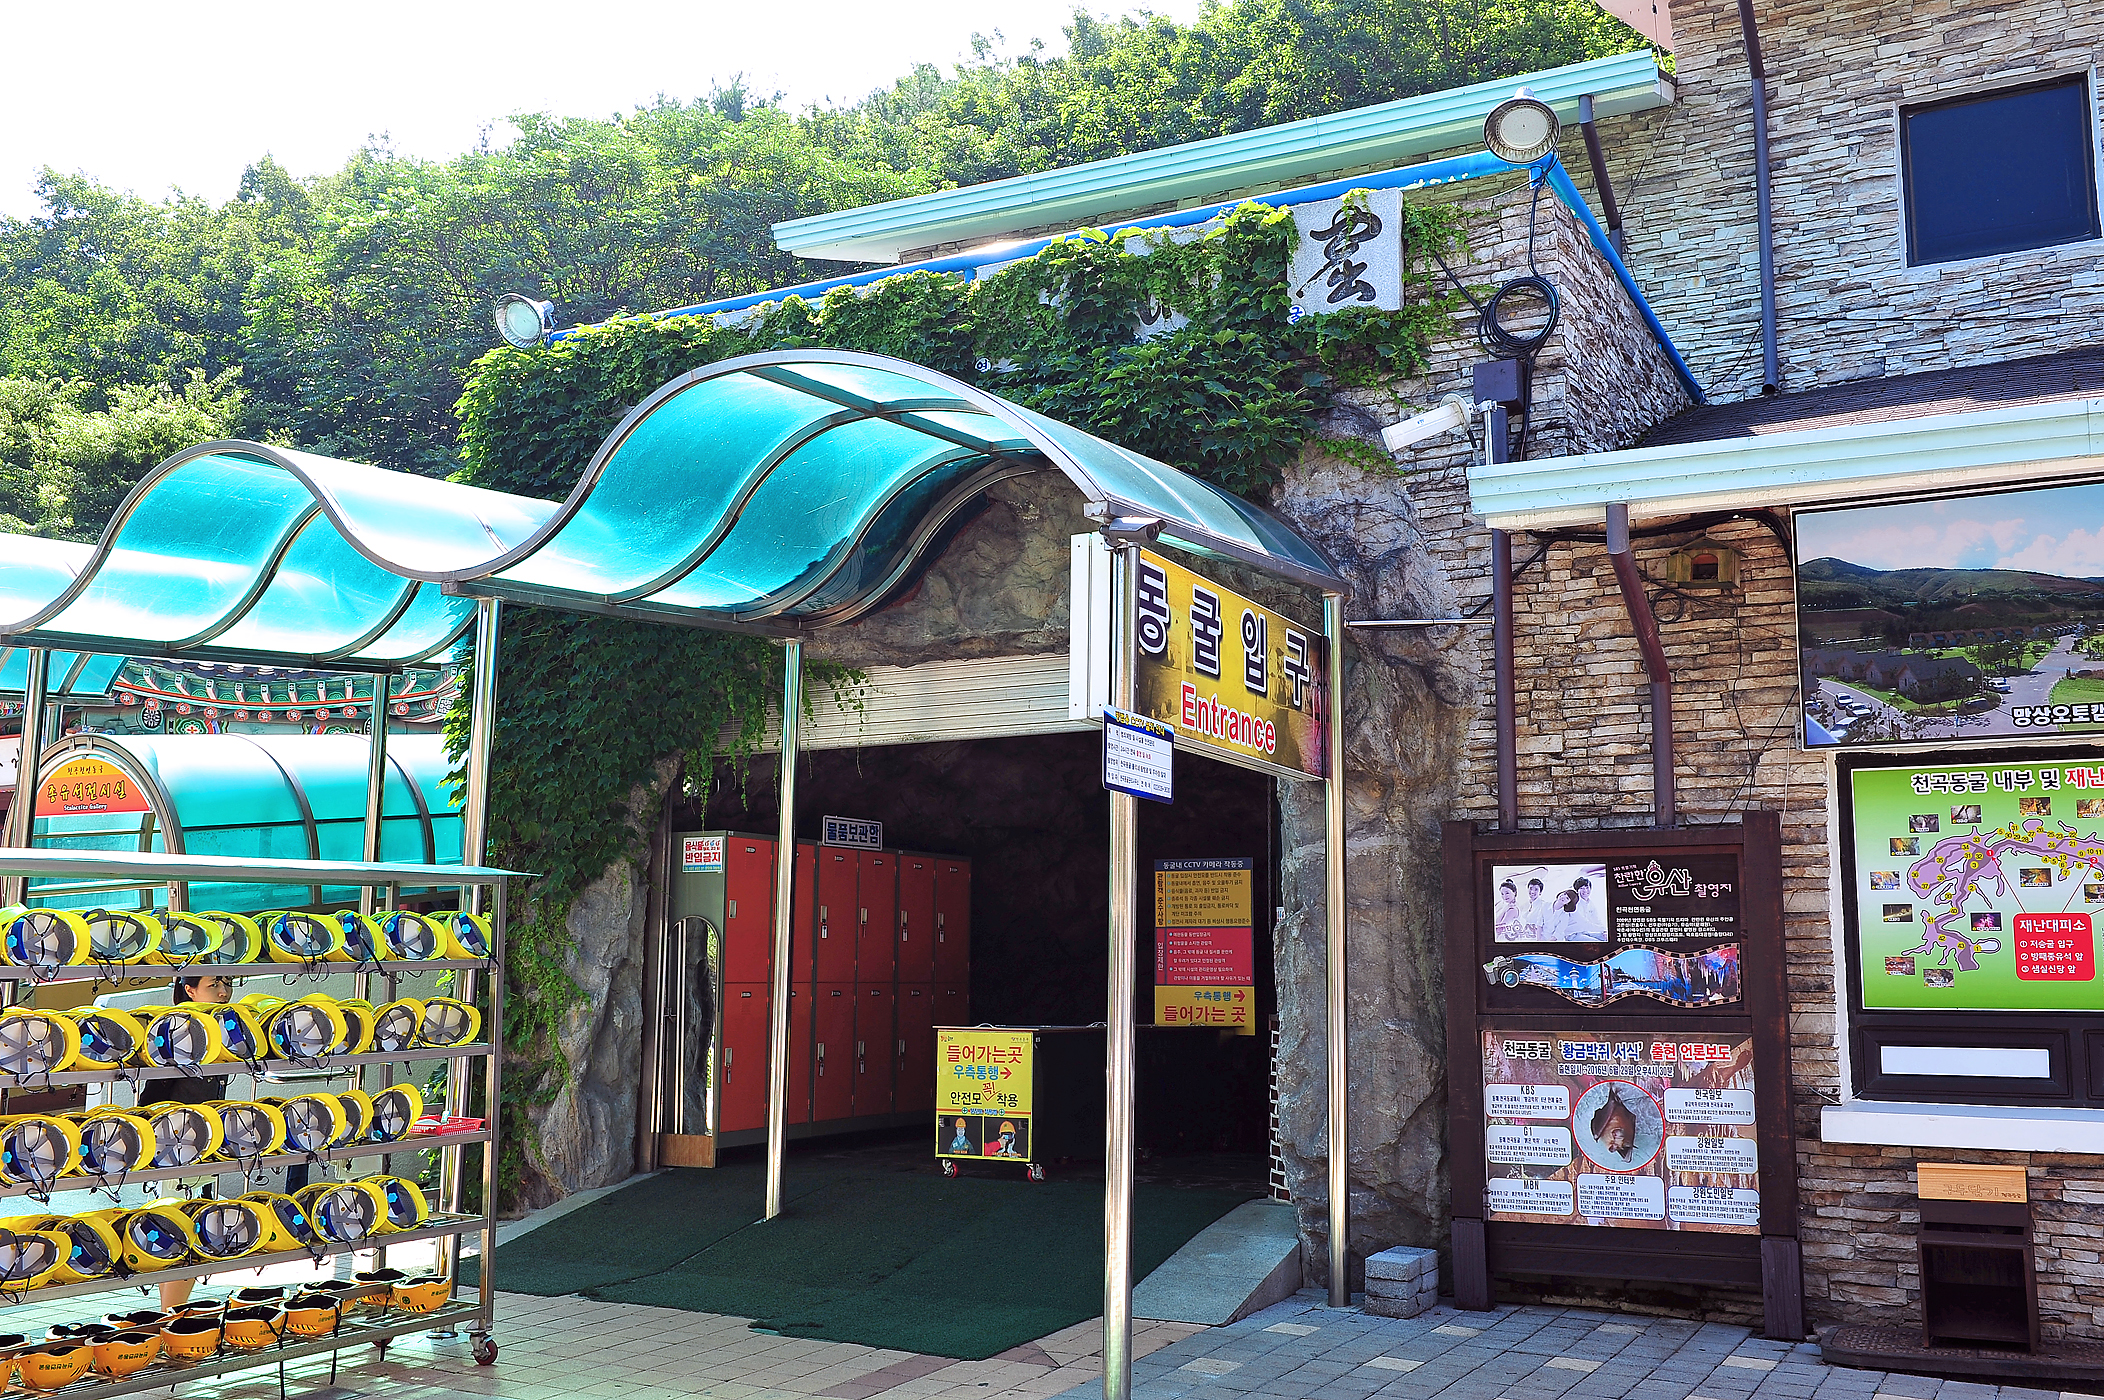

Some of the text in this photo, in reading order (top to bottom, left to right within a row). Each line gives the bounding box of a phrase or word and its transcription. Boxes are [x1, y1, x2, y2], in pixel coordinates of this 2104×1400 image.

[1139, 560, 1311, 706] 동굴입구
[1180, 681, 1276, 755] Entrance
[1913, 768, 2104, 793] 천곡동굴 내부 및 재난
[48, 780, 127, 803] 종유석전시실
[827, 822, 878, 843] 물품보관함
[685, 852, 720, 863] 반입금지
[1163, 861, 1182, 869] 동굴내
[1202, 861, 1222, 869] 카메라
[1223, 860, 1244, 868] 작동중
[1694, 883, 1732, 898] 촬영지
[2019, 919, 2087, 933] 재난대피소
[2057, 940, 2074, 949] 입구
[2075, 952, 2084, 961] 앞
[2067, 965, 2076, 974] 앞
[1194, 991, 1231, 1001] 우측통행
[1164, 1005, 1246, 1023] 들어가는 곳
[946, 1045, 1023, 1064] 들어가는곳
[1504, 1041, 1551, 1059] 천곡동굴
[1652, 1042, 1676, 1060] 출현
[1681, 1043, 1731, 1061] 언론보도
[953, 1065, 999, 1080] 우측통행
[982, 1082, 996, 1095] 꼭!
[1520, 1085, 1535, 1095] KBS
[950, 1092, 1018, 1108] 안전모 착용
[1524, 1126, 1533, 1136] G1
[1697, 1137, 1725, 1149] 강원일보
[1523, 1180, 1540, 1190] MBN
[1604, 1175, 1636, 1185] 주요 인터넷
[1692, 1187, 1734, 1199] 강원도민일보
